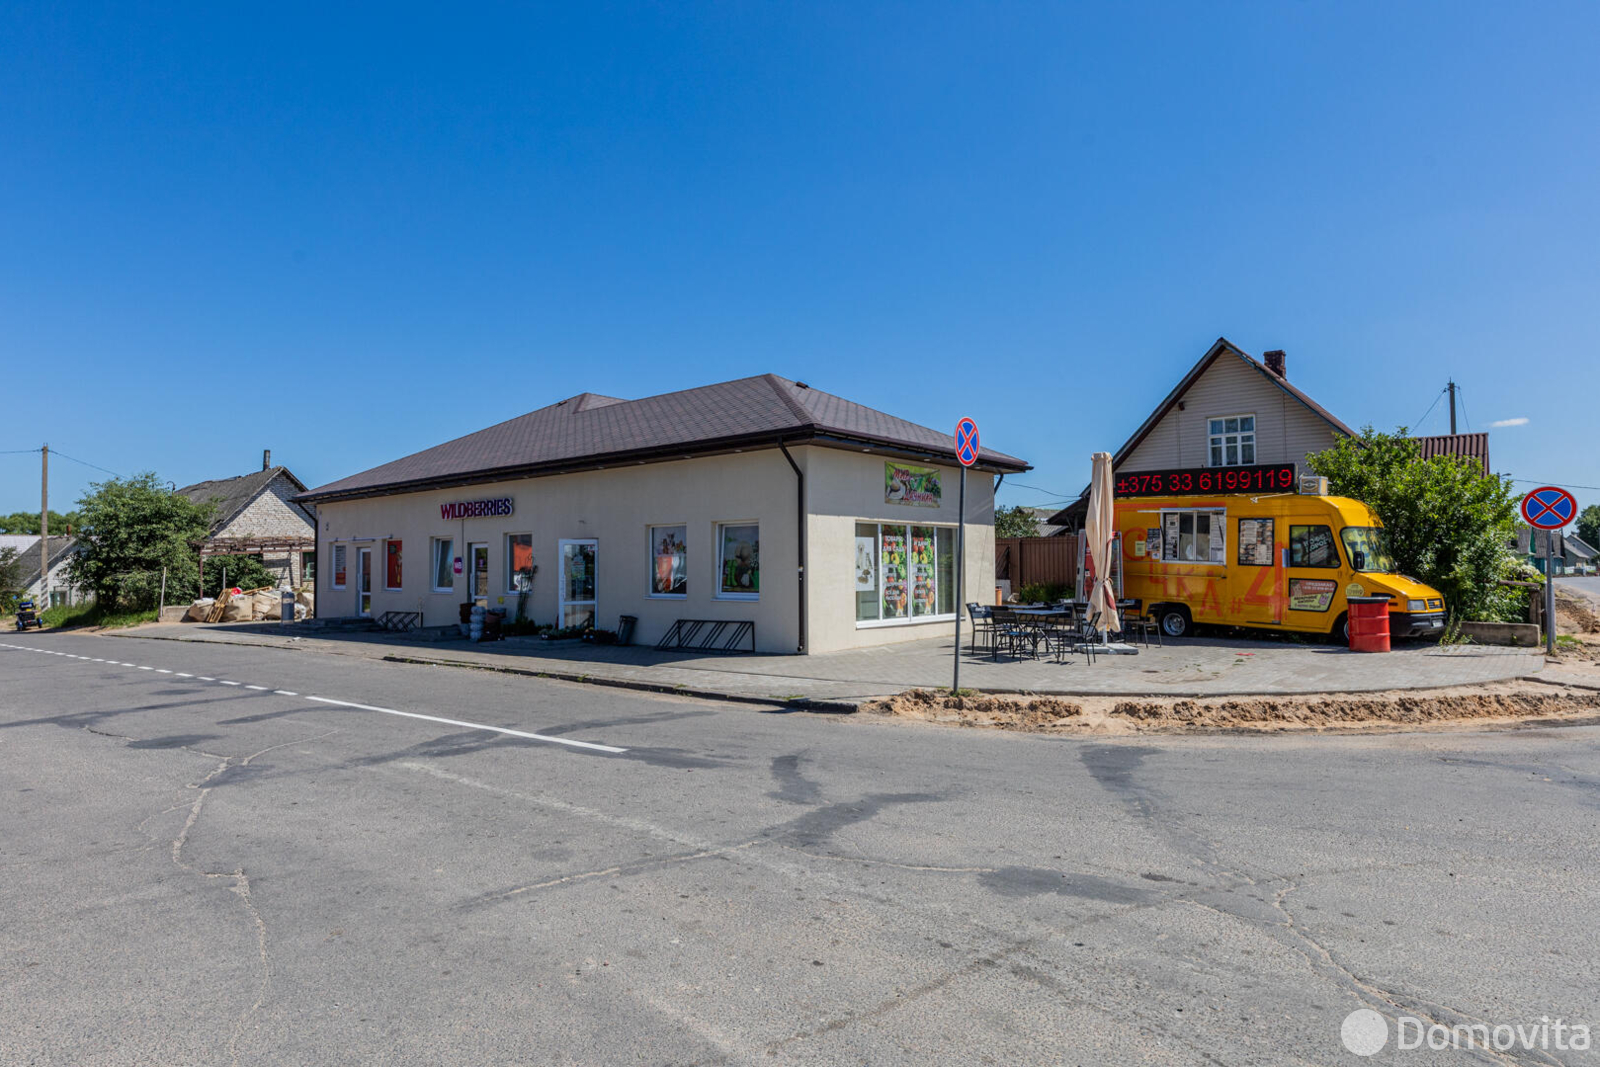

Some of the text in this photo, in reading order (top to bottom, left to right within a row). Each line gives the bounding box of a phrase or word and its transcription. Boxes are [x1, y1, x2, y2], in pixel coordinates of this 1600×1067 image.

[1169, 473, 1193, 491] 33
[1200, 469, 1292, 490] 6199119
[440, 498, 513, 520] WILDBERRIES
